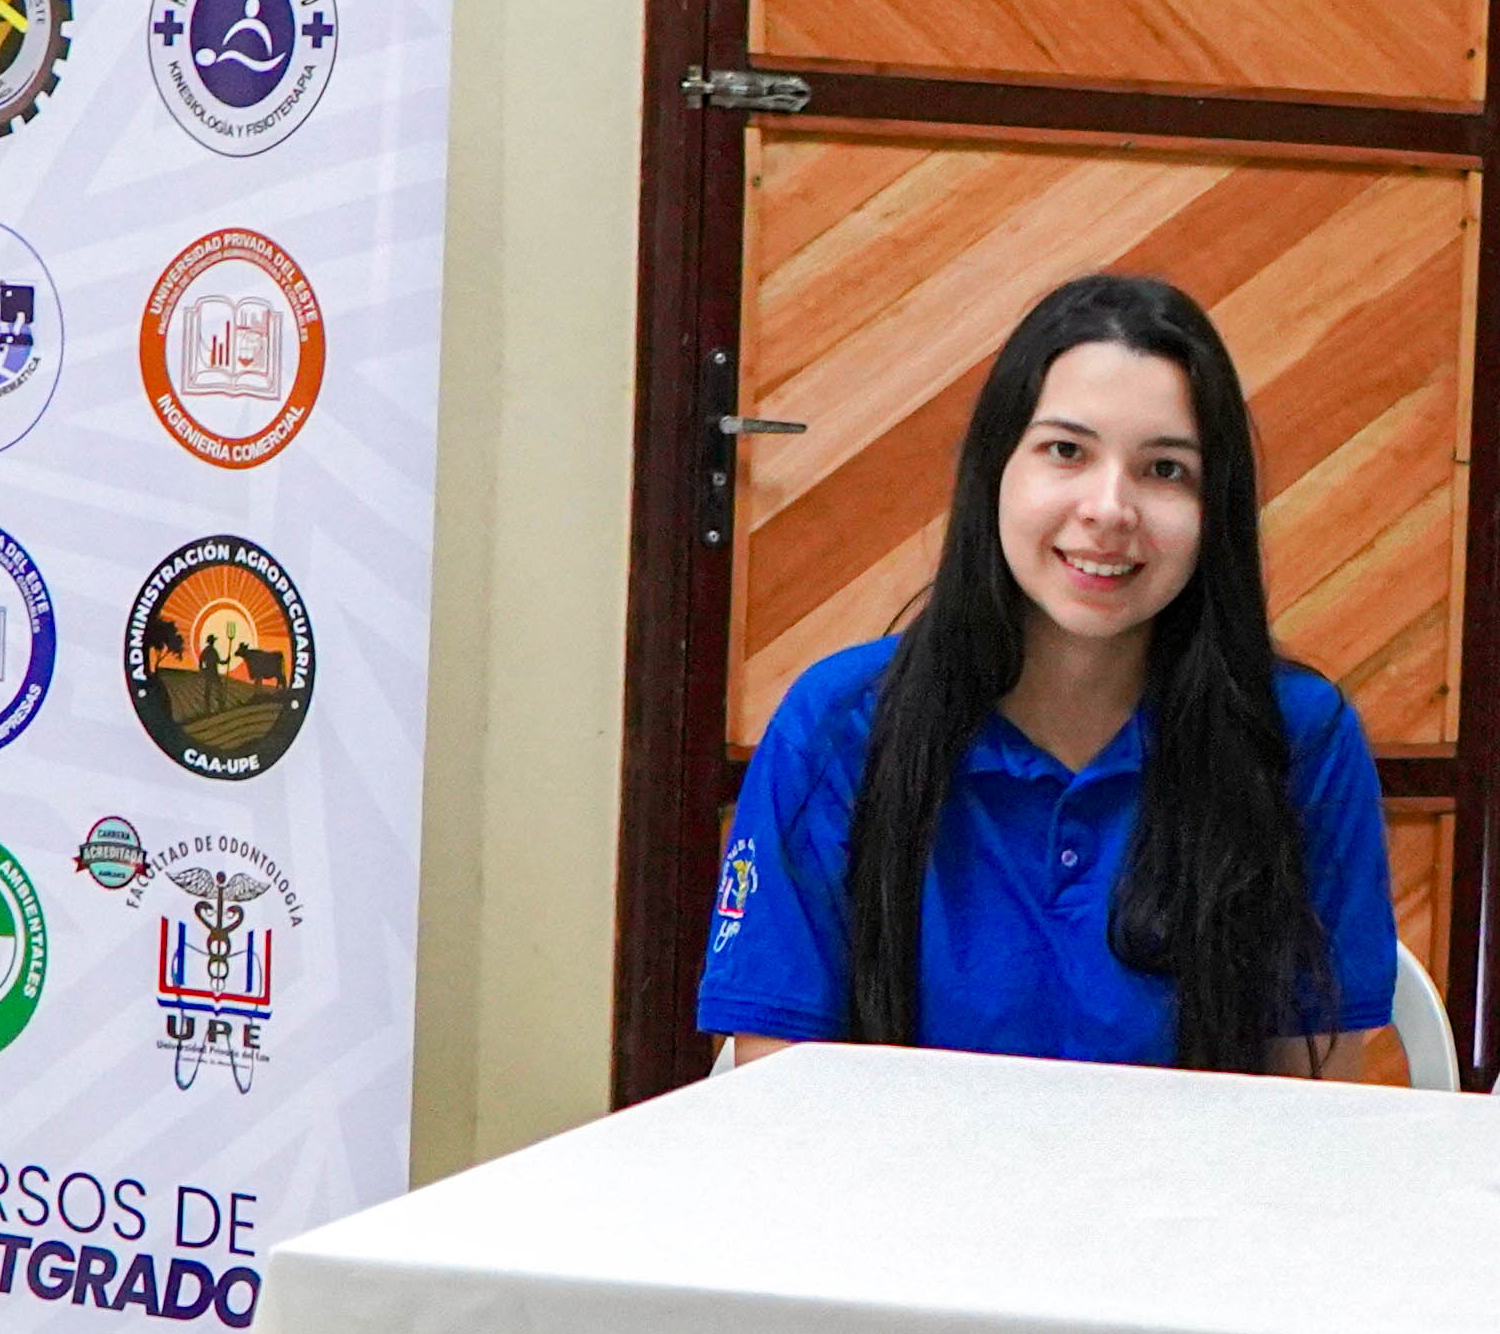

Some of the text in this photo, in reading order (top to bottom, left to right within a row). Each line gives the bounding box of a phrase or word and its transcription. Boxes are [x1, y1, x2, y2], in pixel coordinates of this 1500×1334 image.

[246, 63, 317, 137] FISIOTERAPIA
[150, 233, 319, 322] UNIVERSIDAD PRIVADA DEL ESTE
[232, 404, 305, 462] COMERCIAL
[5, 543, 29, 572] DEL
[25, 570, 50, 614] ESTE
[129, 540, 230, 682] ADMINISTRACIÓN
[234, 546, 310, 691] AGROPECUARIA
[183, 748, 261, 774] CAA-UPE
[194, 835, 213, 853] DE
[218, 835, 304, 928] ODONTOLOGÍA
[166, 1014, 261, 1050] UPE
[176, 1186, 259, 1257] DE
